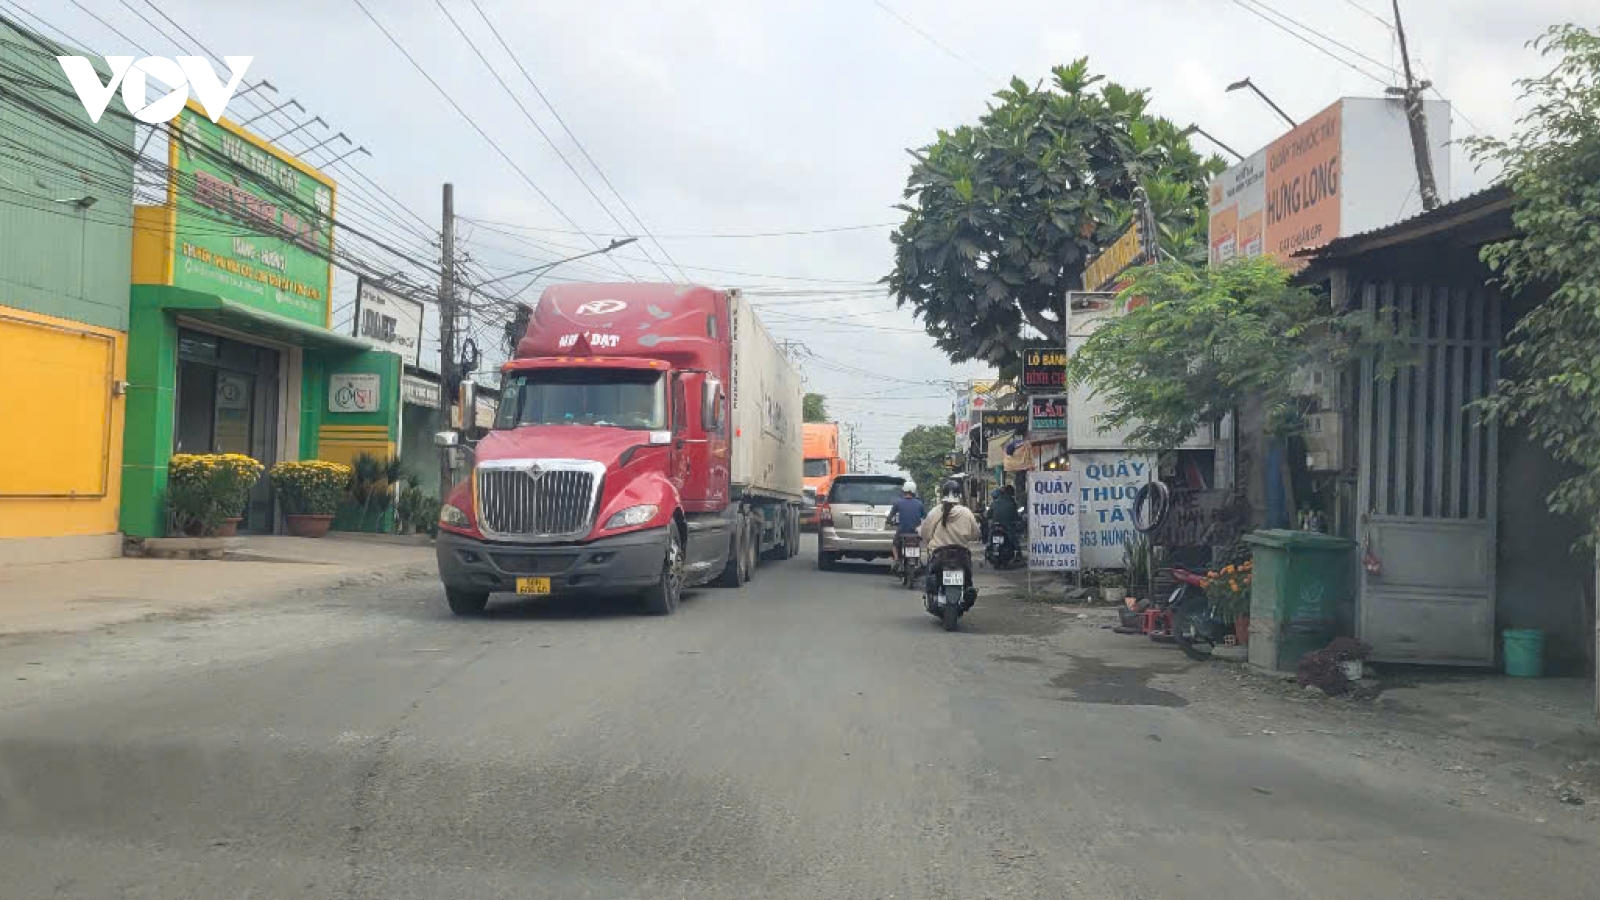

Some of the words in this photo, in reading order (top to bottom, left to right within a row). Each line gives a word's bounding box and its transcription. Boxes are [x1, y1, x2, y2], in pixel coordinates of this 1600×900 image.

[1303, 156, 1337, 208] LONG
[1033, 499, 1075, 516] THUỐC
[1041, 522, 1066, 538] TÂY
[1055, 543, 1076, 555] LONG
